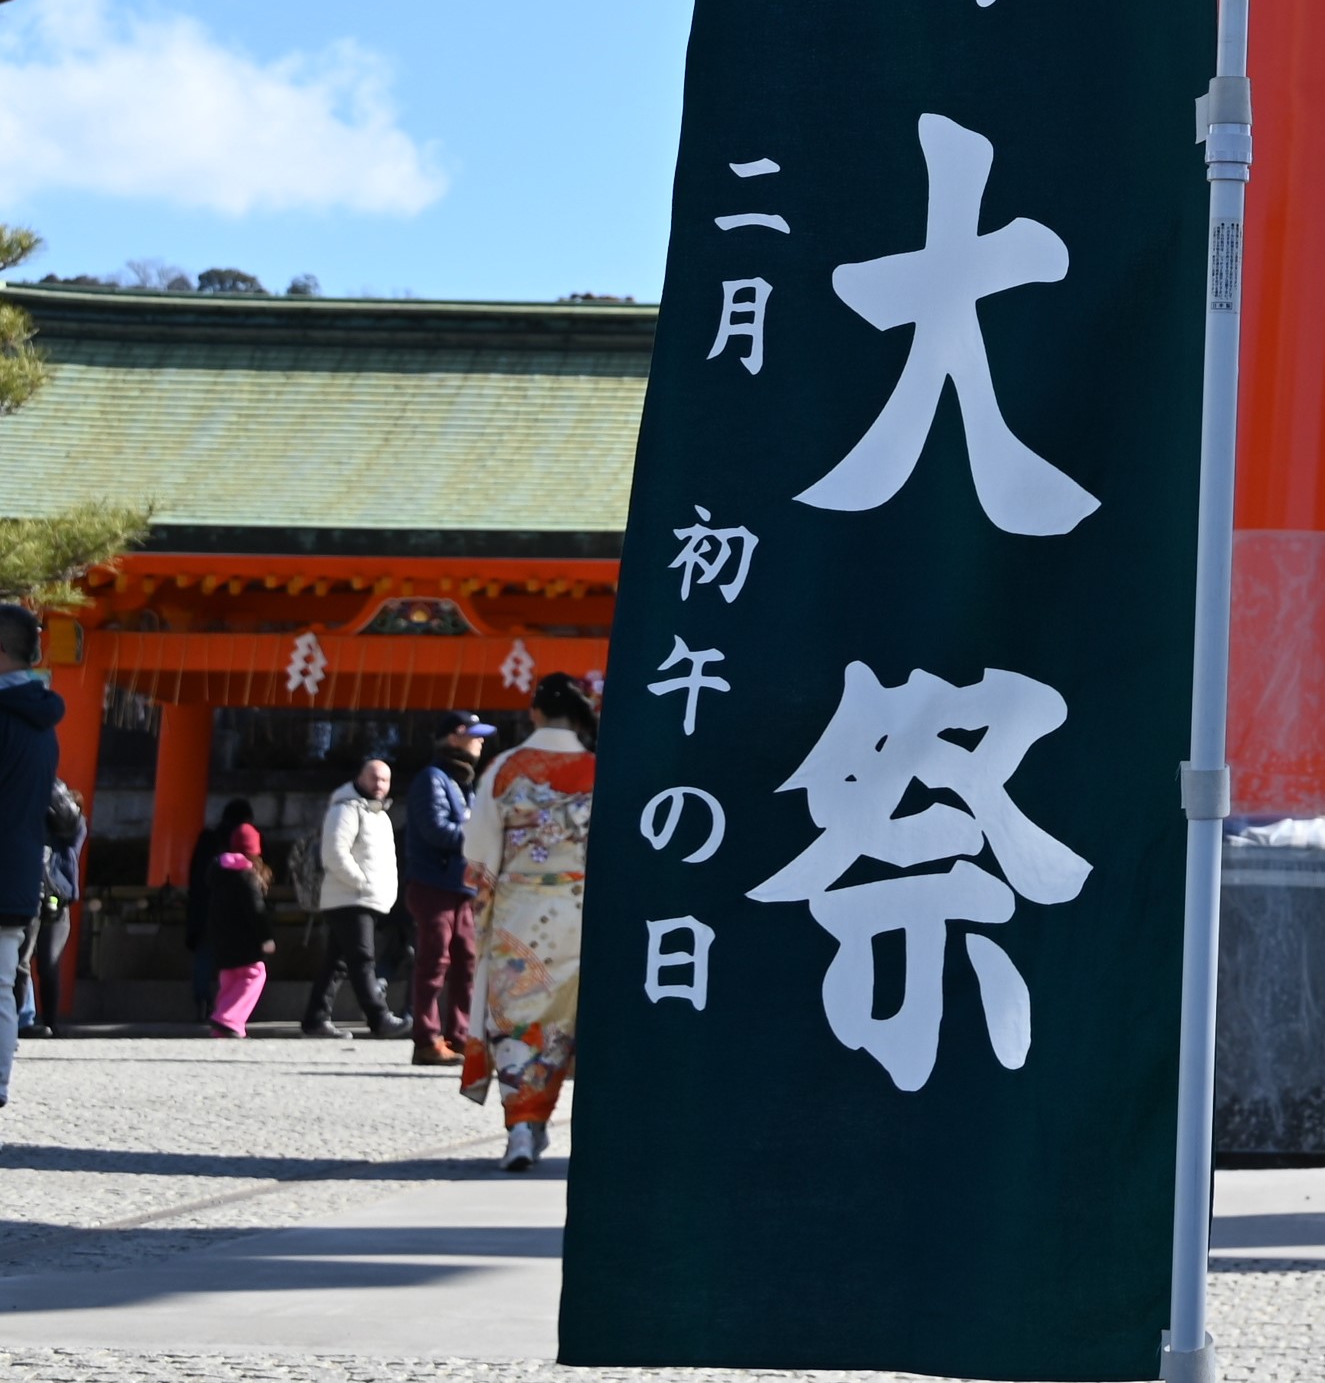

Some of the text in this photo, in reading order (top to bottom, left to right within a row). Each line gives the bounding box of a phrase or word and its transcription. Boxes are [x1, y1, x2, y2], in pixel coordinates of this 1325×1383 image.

[640, 158, 790, 1011] 二月 初午の日
